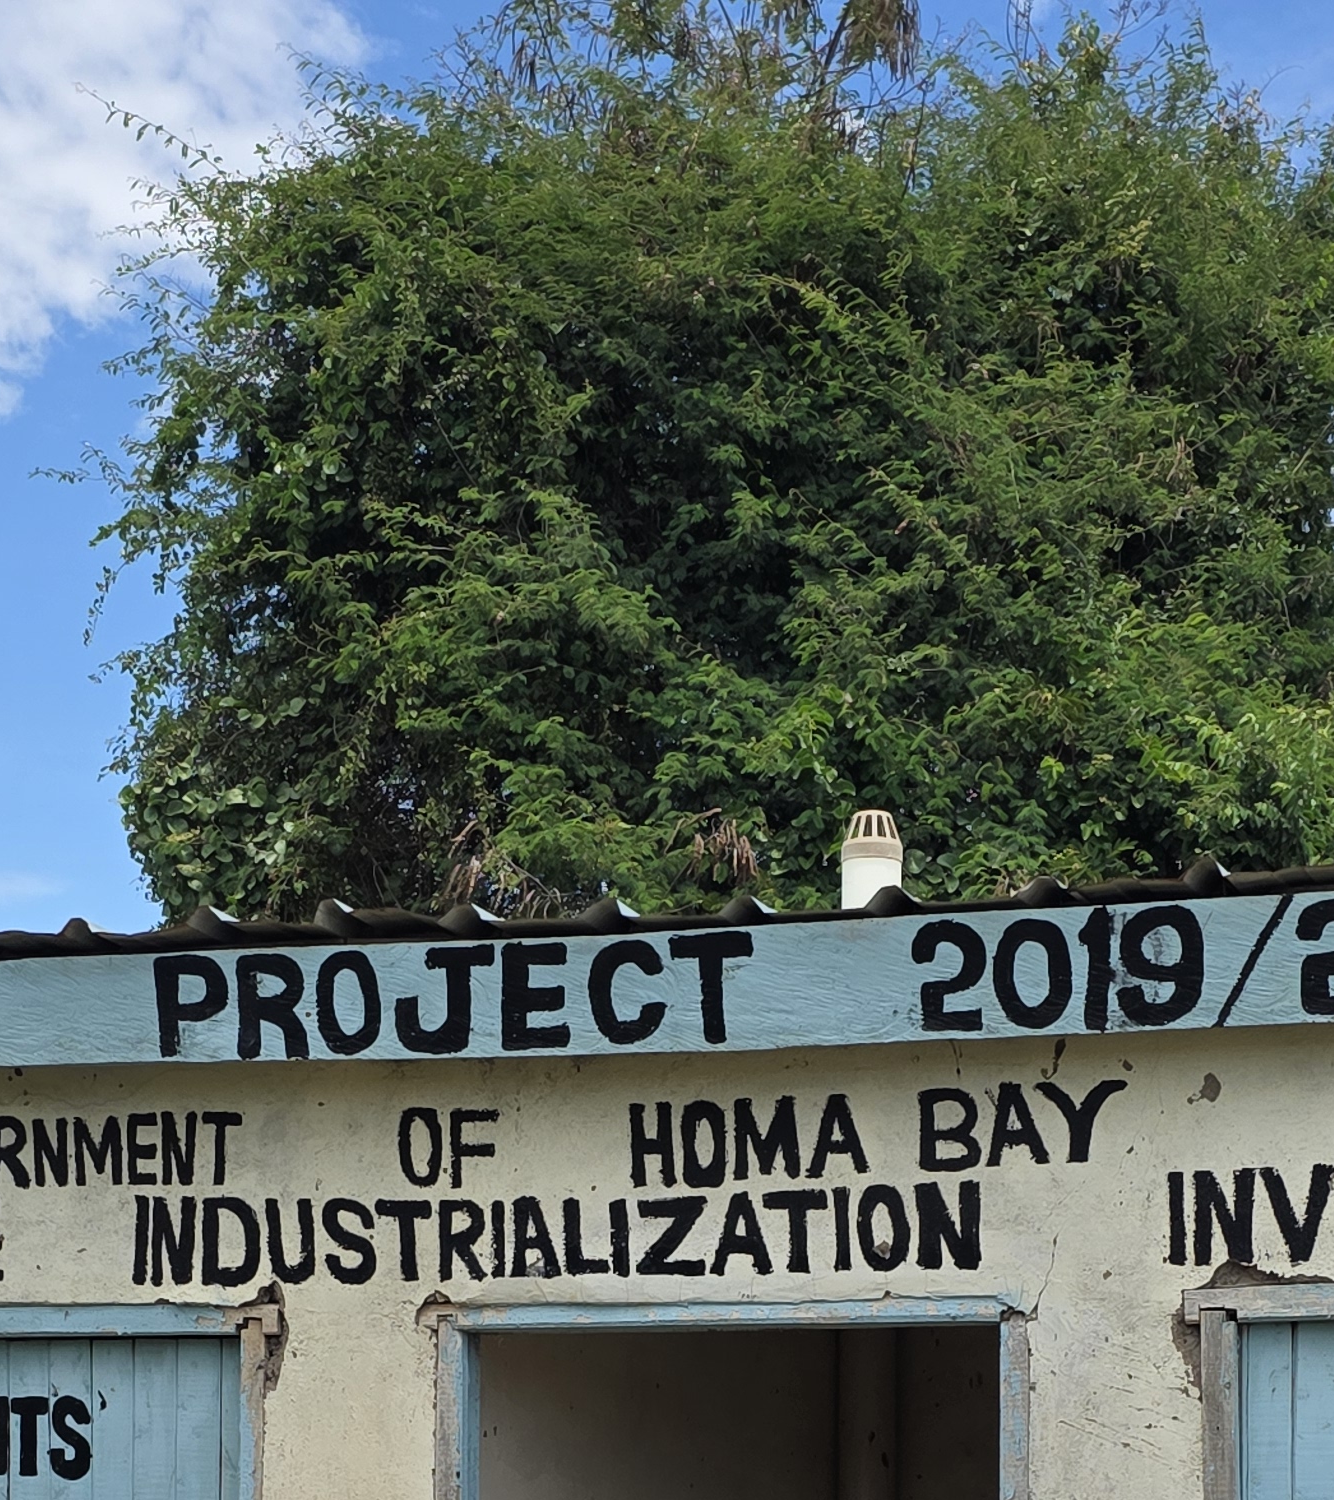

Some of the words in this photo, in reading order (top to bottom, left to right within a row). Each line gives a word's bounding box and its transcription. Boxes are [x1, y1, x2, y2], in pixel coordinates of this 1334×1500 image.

[153, 930, 754, 1060] PROJECT
[397, 1107, 500, 1189] OF
[629, 1093, 869, 1189] HOMA
[917, 1079, 1128, 1173] BAY
[133, 1180, 982, 1287] INDUSTRIALIZATION
